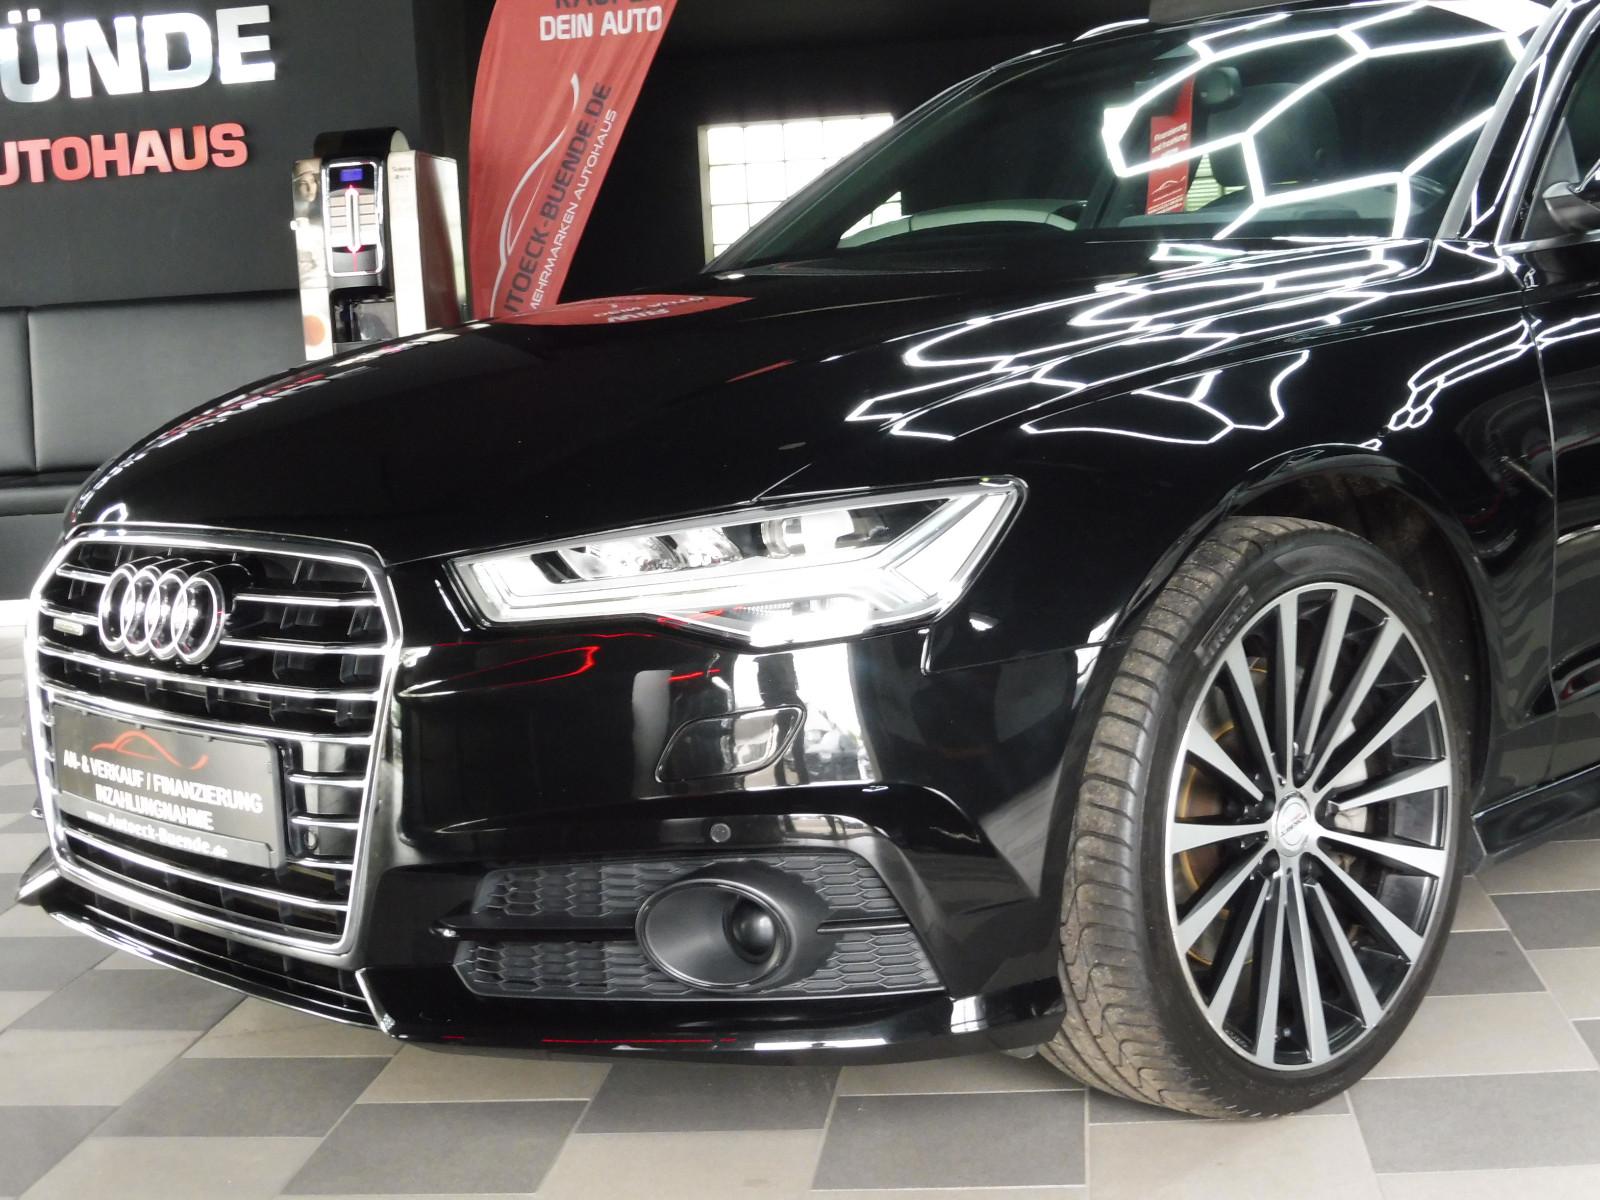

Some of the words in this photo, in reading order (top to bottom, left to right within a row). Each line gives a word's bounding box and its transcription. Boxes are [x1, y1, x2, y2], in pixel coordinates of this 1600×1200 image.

[0, 4, 276, 103] ÜNDE
[539, 13, 593, 41] DEIN
[600, 5, 663, 36] AUTO
[573, 108, 618, 201] AUTOHAUS
[89, 757, 145, 788] VERKAUF
[153, 773, 264, 814] FINANZIERUNG
